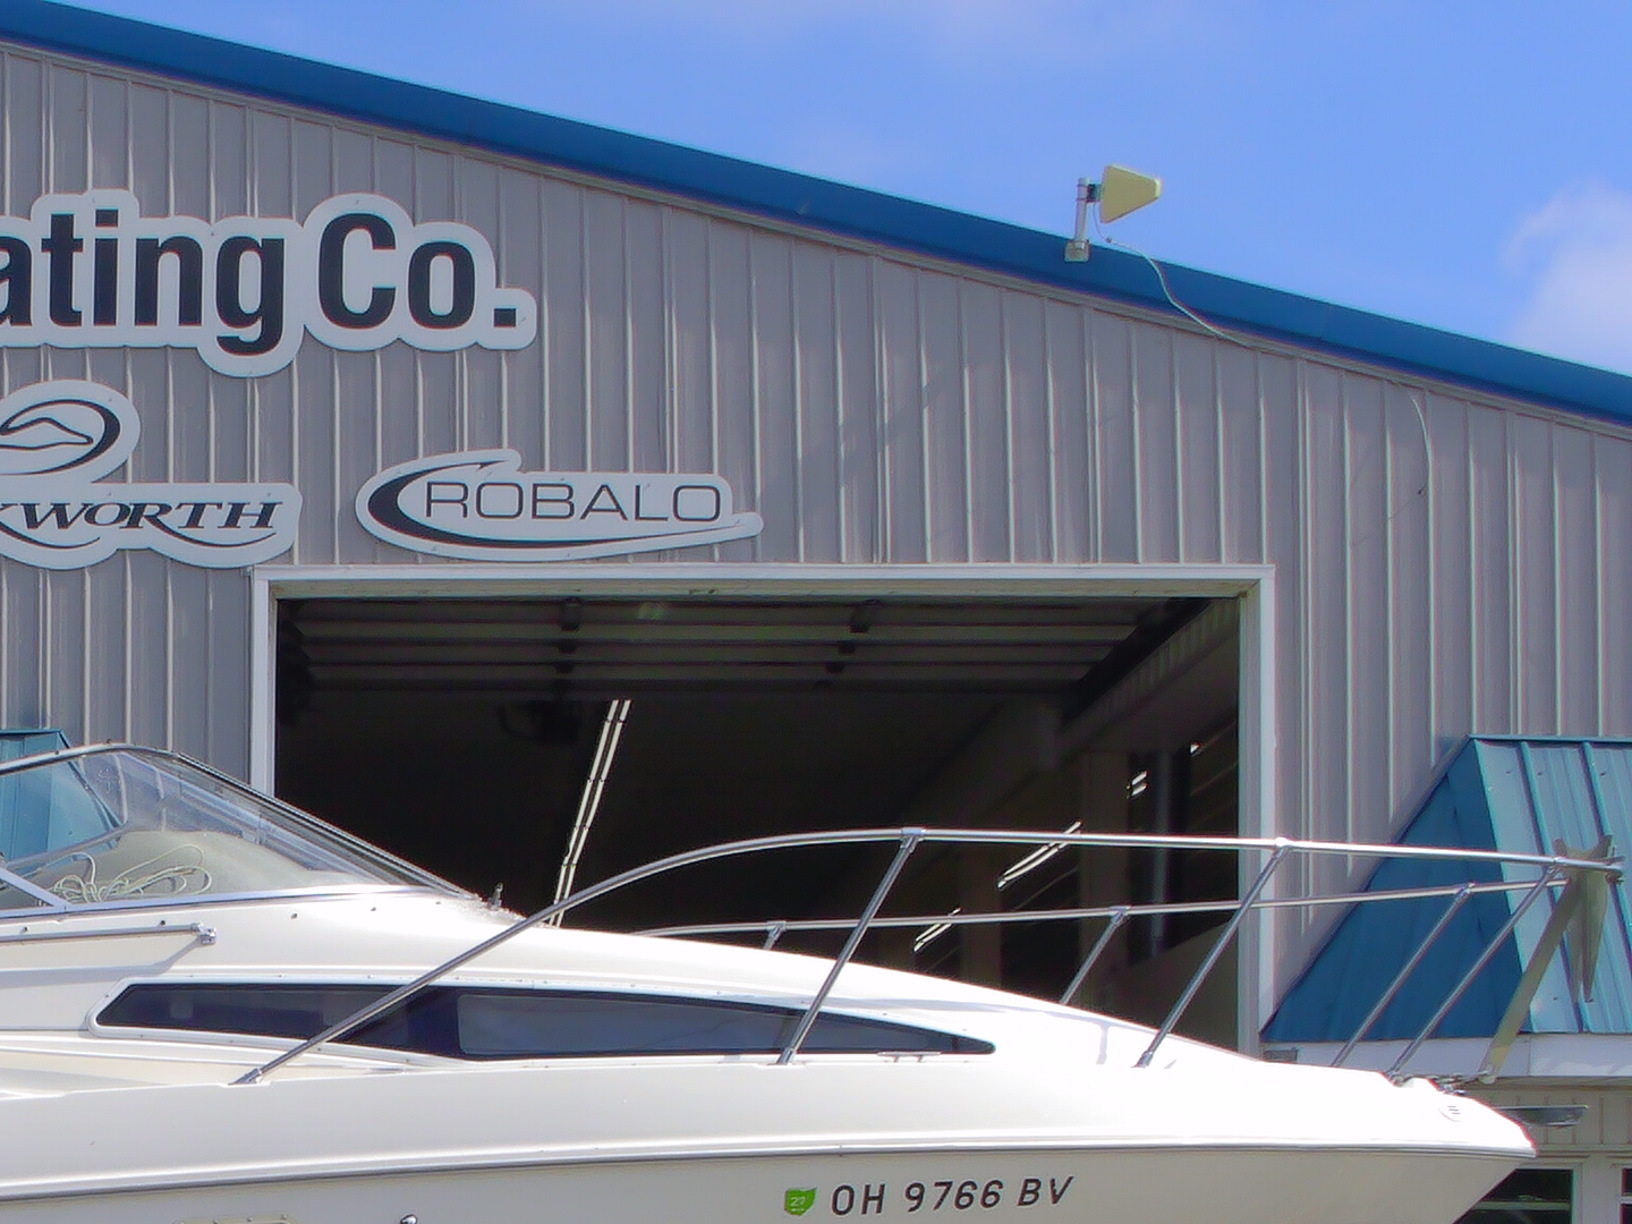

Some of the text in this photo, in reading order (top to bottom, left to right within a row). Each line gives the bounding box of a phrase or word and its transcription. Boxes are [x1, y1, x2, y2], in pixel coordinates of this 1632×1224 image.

[317, 212, 517, 331] Co.
[425, 481, 721, 522] ROBALO
[831, 1175, 1074, 1216] OH 9766 BV
